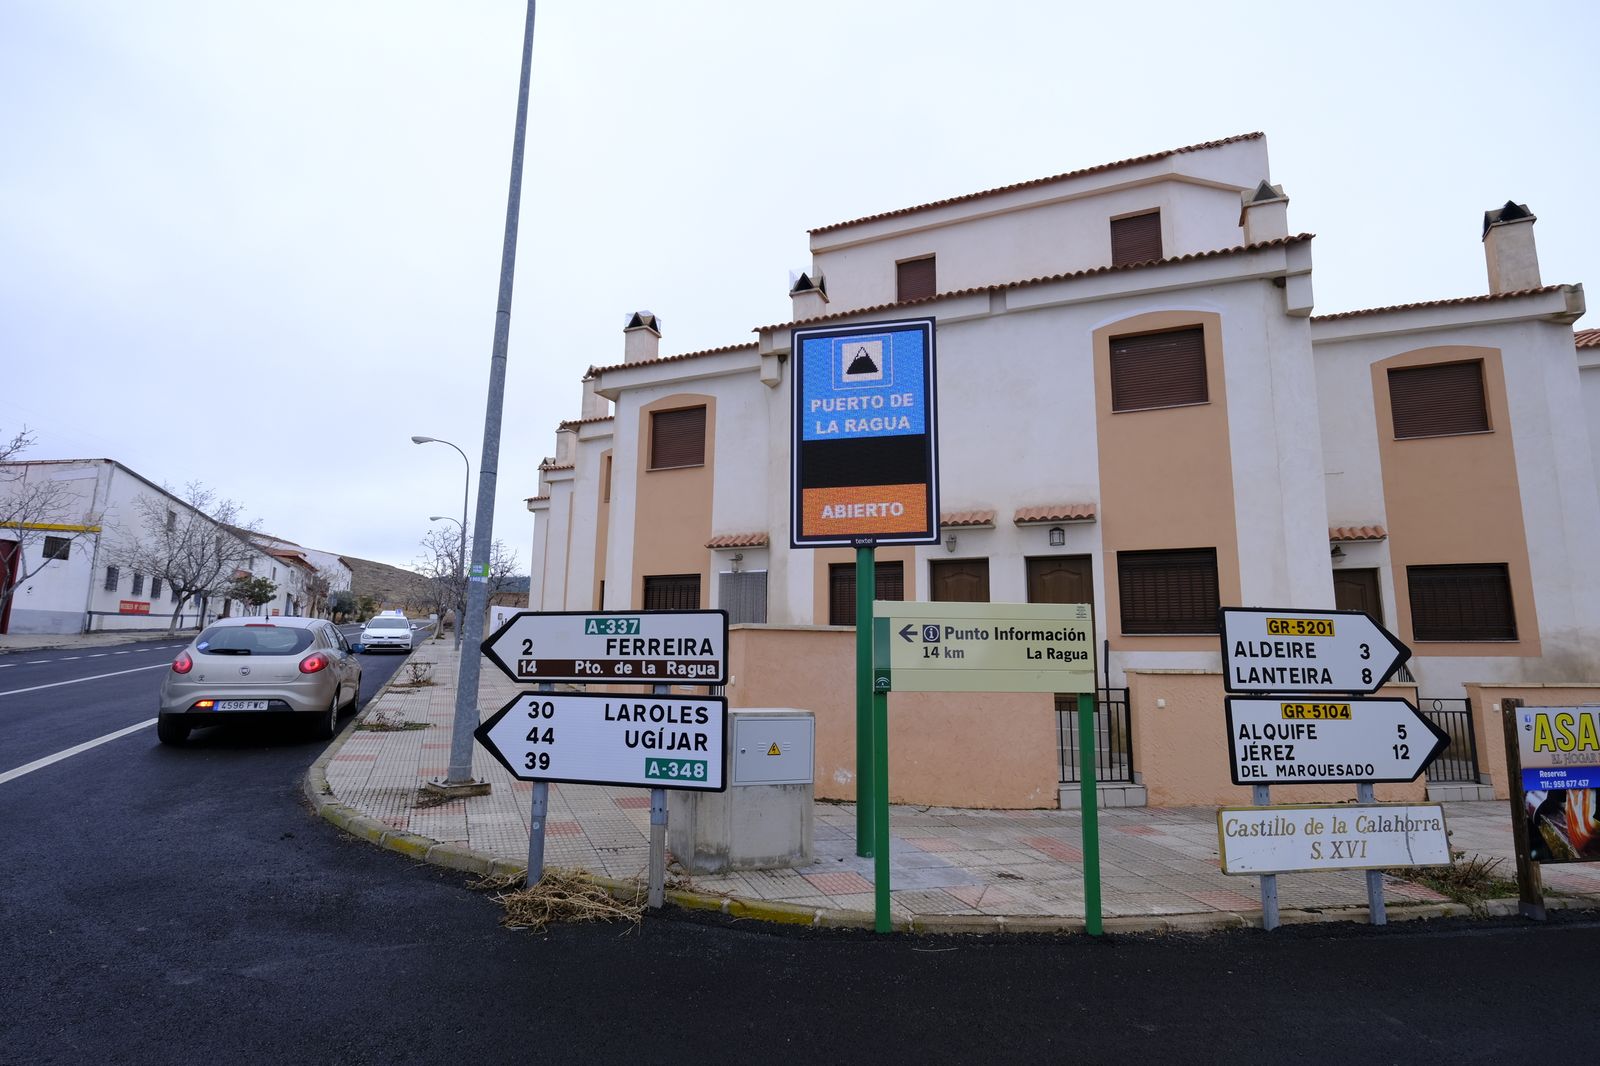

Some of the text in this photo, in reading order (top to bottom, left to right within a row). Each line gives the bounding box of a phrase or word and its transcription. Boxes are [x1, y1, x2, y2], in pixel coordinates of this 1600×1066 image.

[811, 393, 914, 413] PUERTO DE
[816, 416, 911, 435] LA RAGUA
[821, 502, 904, 519] ABIERTO
[587, 618, 640, 635] A-337
[944, 626, 1087, 642] Punto Información
[1268, 620, 1334, 635] GR-5201
[521, 638, 714, 656] 2 FERREIRA
[922, 646, 965, 659] 14 km
[1026, 648, 1089, 663] La Ragua
[1234, 641, 1371, 660] ALDEIRE 3
[520, 660, 716, 679] 14 Pto. de la Ragua
[1236, 667, 1373, 685] LANTEIRA 8
[221, 701, 245, 710] 4596
[527, 701, 709, 725] 30 LAROLES
[1283, 705, 1350, 719] GR-5104
[526, 727, 708, 752] 44 UGÍJAR
[1238, 723, 1408, 741] ALQUIFE 5
[1533, 712, 1600, 752] ASA
[1241, 741, 1410, 762] JÉREZ 12
[524, 752, 550, 770] 39
[648, 760, 705, 778] A-348
[1241, 764, 1375, 778] DEL MARQUESADO
[1539, 770, 1567, 778] Reservas
[1225, 814, 1441, 838] Castillo de la Calahorra
[1310, 840, 1367, 860] S. XVI
